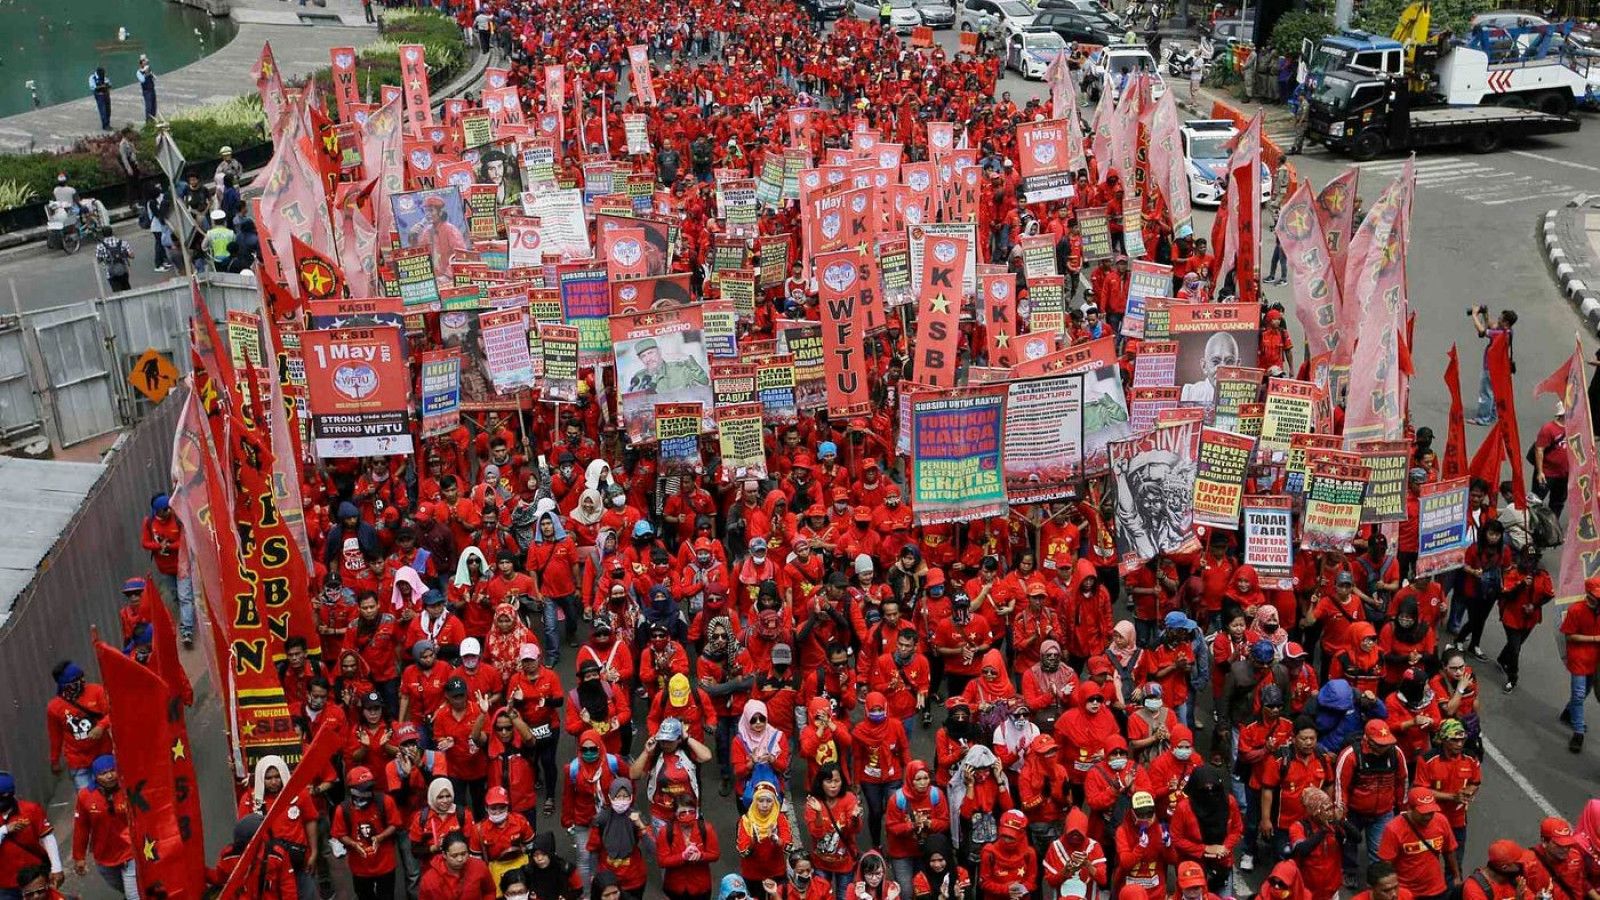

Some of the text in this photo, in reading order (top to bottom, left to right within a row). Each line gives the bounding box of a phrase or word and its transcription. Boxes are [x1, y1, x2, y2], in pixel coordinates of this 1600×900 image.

[1024, 130, 1057, 147] 1 May
[654, 322, 691, 336] CASTRO
[1175, 321, 1255, 332] MAHATMA GANDHI
[828, 296, 859, 395] WFTU
[313, 344, 328, 369] 1
[329, 345, 377, 361] May
[1050, 383, 1078, 393] Indonesia
[718, 393, 751, 402] CABUT
[1016, 390, 1072, 403] SEPULTURA
[915, 397, 1003, 411] SUBSIDI UNTUK RAKYAT
[320, 415, 362, 425] STRONG
[382, 412, 402, 420] unions
[919, 409, 997, 429] TURUNKAN
[322, 423, 403, 434] STRONG WFTU
[919, 424, 995, 445] HARGA
[1202, 442, 1249, 458] HAPUS
[921, 456, 980, 469] PENDIDIKAN
[1200, 457, 1246, 469] KONTRAK
[1201, 451, 1247, 465] KERJA
[1361, 456, 1406, 475] TANGKAP
[920, 470, 998, 491] GRATIS
[921, 488, 959, 500] UNTUK
[960, 484, 999, 498] RAKYAT
[1198, 481, 1239, 497] UPAH
[1373, 481, 1403, 495] ADILI
[1196, 493, 1236, 506] LAYAK
[1424, 490, 1463, 511] ANGKAT
[1375, 501, 1403, 516] NAKAL
[1249, 513, 1288, 525] TANAH
[1260, 526, 1287, 537] AIR
[1248, 537, 1288, 546] UNTUK
[1248, 553, 1289, 563] RAKYAT
[345, 560, 367, 571] ONE
